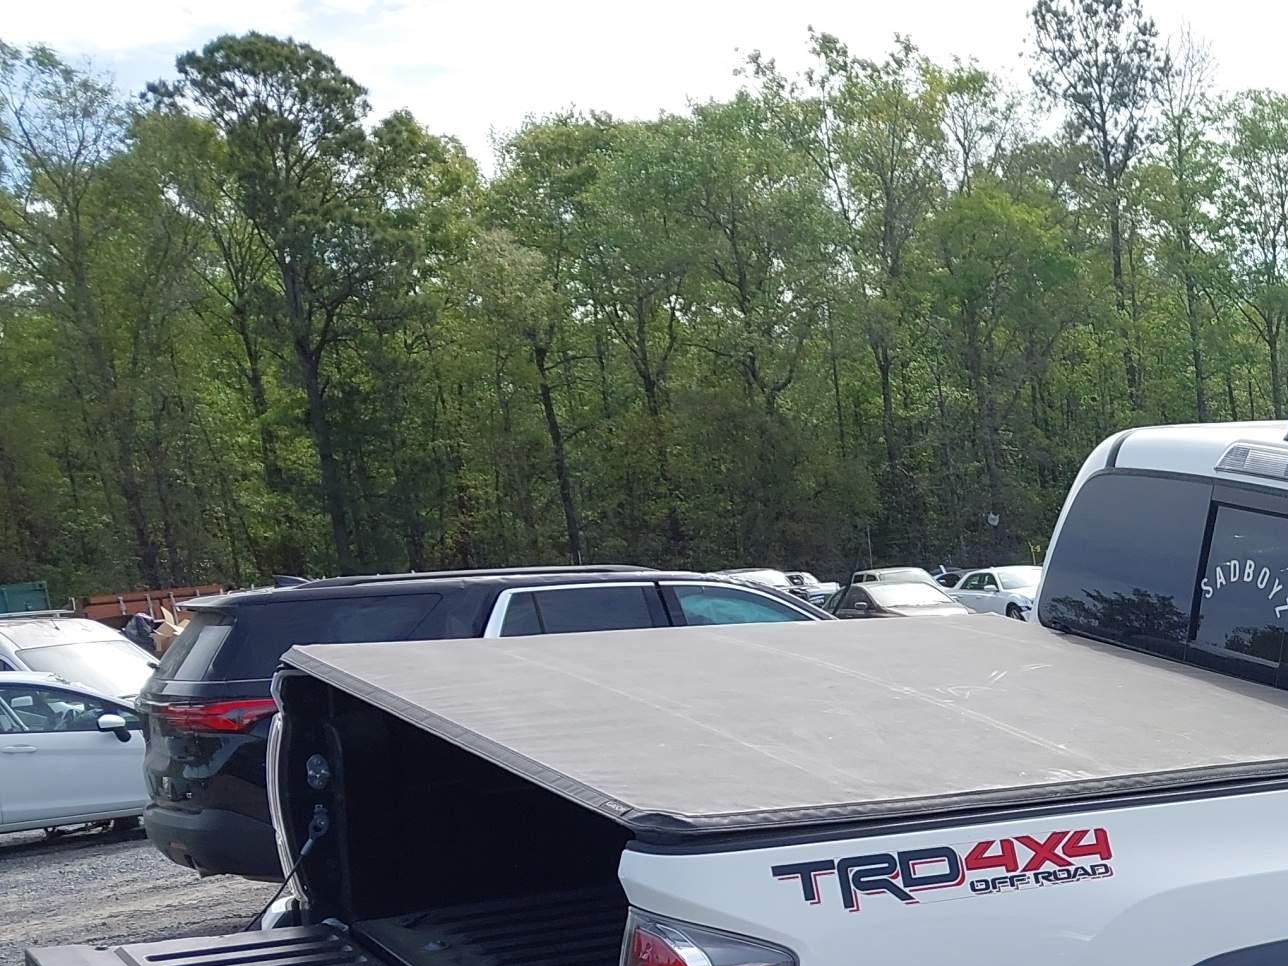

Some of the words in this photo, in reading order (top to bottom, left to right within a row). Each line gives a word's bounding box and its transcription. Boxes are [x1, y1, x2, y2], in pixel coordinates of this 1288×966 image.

[771, 846, 967, 912] TRD
[969, 876, 1029, 894] OFF
[1033, 864, 1114, 888] ROAD
